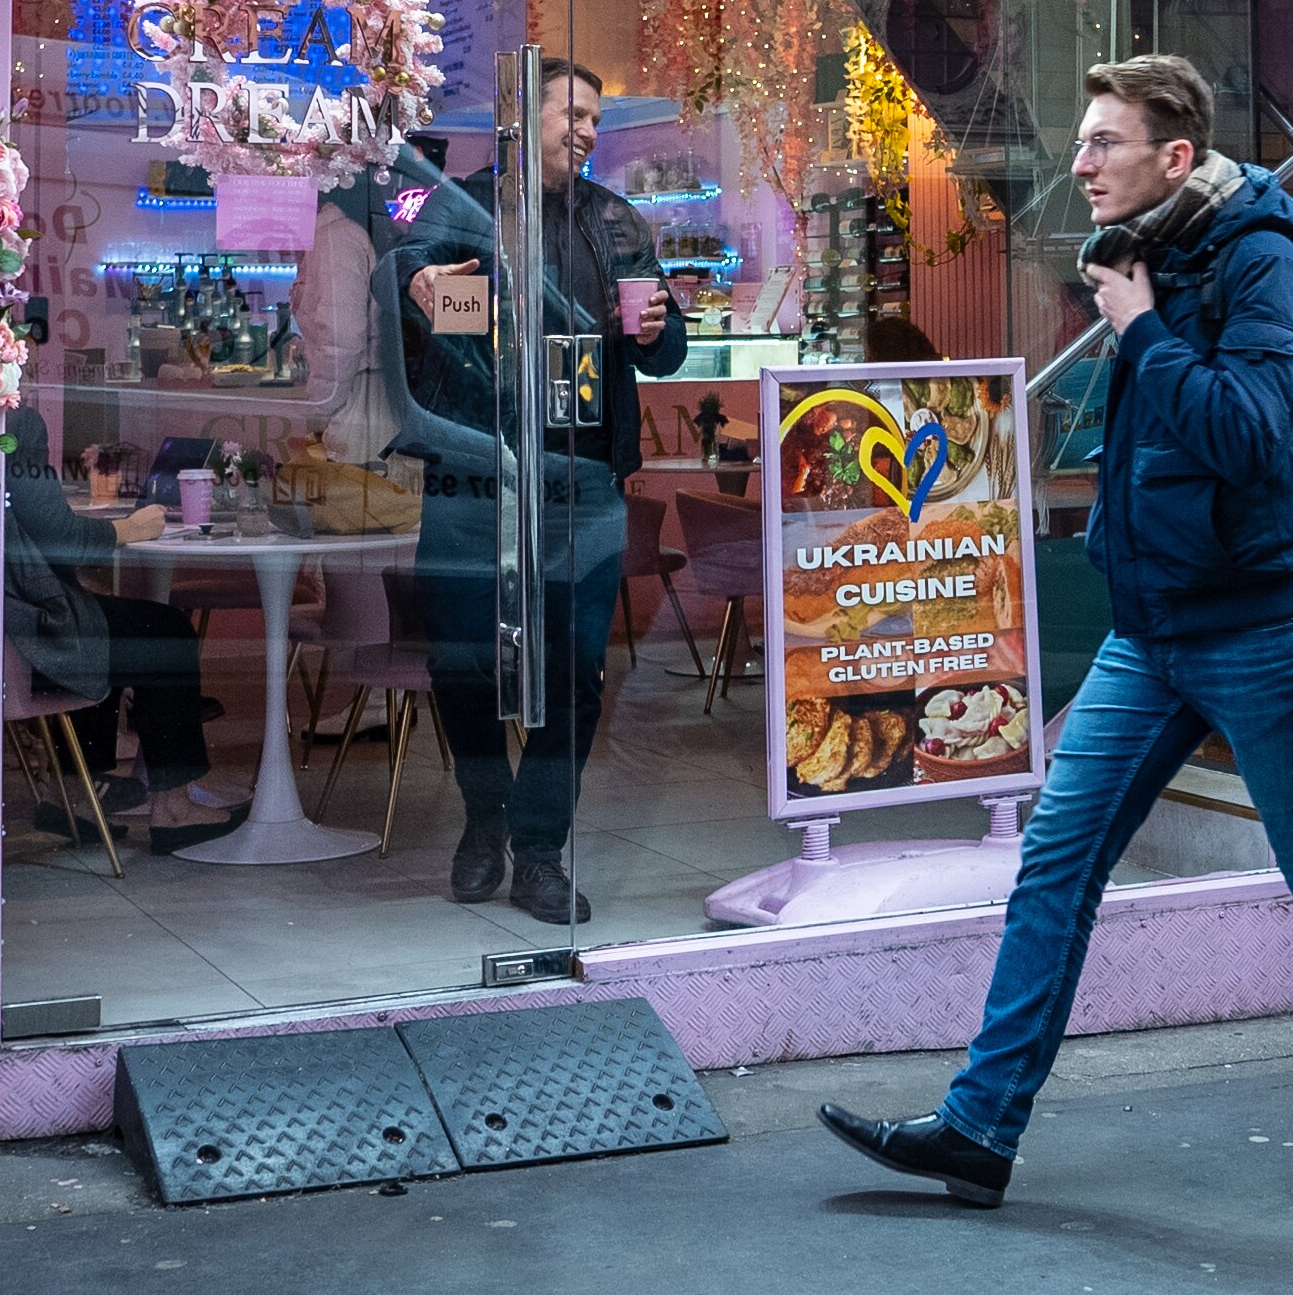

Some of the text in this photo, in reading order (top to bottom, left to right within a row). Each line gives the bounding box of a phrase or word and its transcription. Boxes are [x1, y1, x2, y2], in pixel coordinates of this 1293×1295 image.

[127, 2, 405, 67] CREAM
[130, 81, 406, 145] DREAM
[441, 295, 482, 313] Push
[796, 533, 1006, 571] UKRAINIAN
[835, 573, 978, 609] CUISINE
[819, 631, 996, 664] PLANT-BASED
[827, 652, 989, 684] GLUTEN FREE
